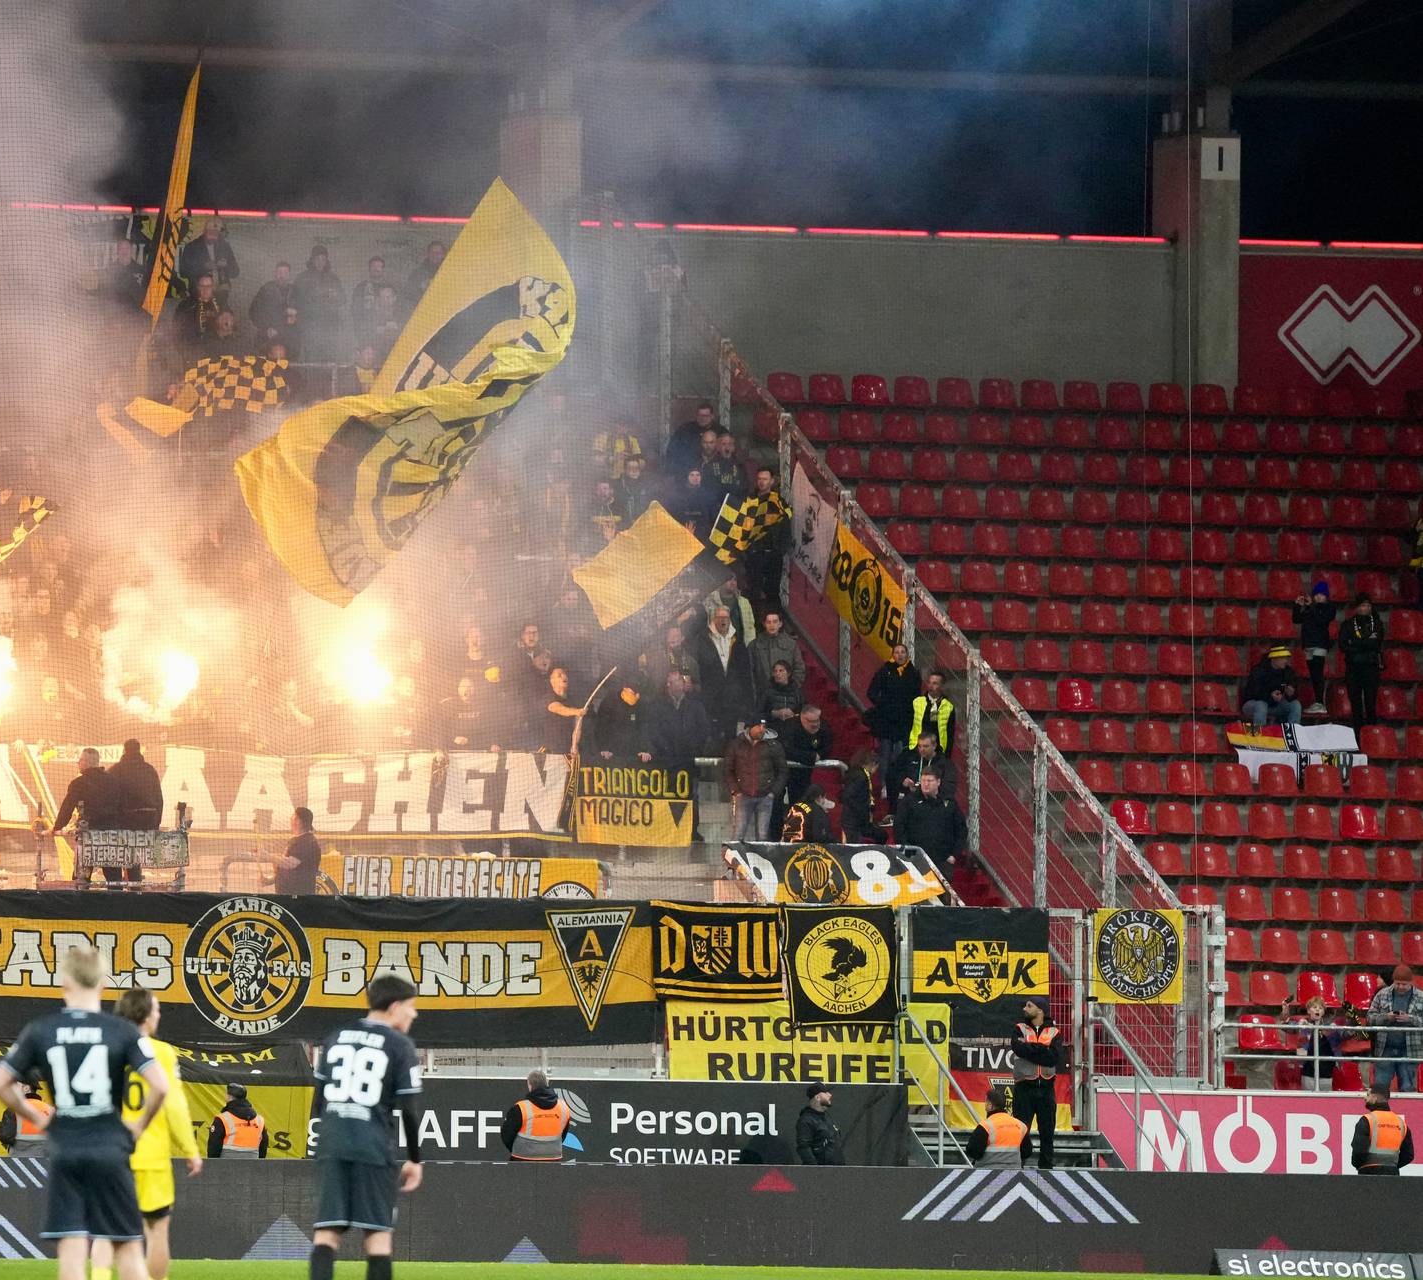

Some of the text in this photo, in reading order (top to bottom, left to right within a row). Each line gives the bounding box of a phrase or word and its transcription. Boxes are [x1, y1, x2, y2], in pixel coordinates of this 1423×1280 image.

[160, 747, 570, 833] AACHEN
[580, 766, 689, 798] TRIANGOLO
[580, 799, 653, 827] MAGICO
[218, 898, 283, 920] KARLS
[556, 914, 626, 927] ALEMANNIA
[804, 917, 883, 947] BLACK EAGLES
[185, 957, 312, 977] ULT RAS
[324, 939, 542, 996] BANDE
[822, 999, 868, 1014] AACHEN
[214, 1013, 282, 1035] BANDE
[672, 1010, 948, 1044] HÜRTGENWALD
[175, 1044, 277, 1066] RIAM
[708, 1052, 919, 1085] RUREIFEL
[47, 1045, 113, 1115] 14
[324, 1044, 389, 1107] 38
[392, 1109, 503, 1149] TAFF
[610, 1102, 778, 1136] Personal
[1140, 1095, 1423, 1175] MÖB
[609, 1146, 741, 1166] SOFTWARE
[1227, 1253, 1407, 1280] si electronics
